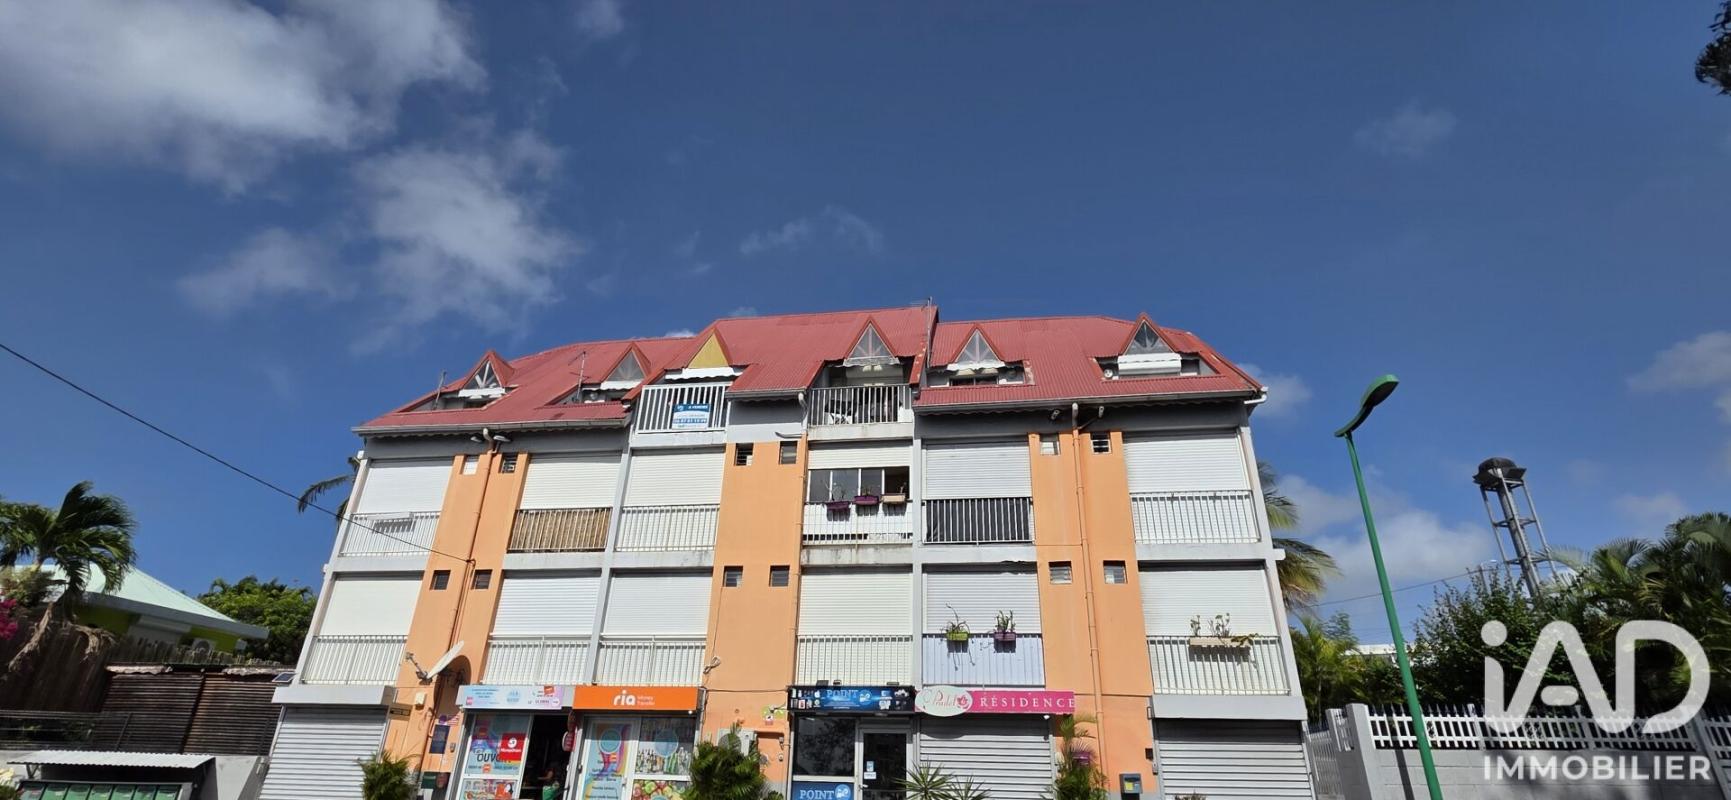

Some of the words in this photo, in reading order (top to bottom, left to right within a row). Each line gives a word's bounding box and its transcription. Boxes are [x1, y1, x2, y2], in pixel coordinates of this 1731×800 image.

[613, 689, 636, 706] ria
[826, 689, 859, 698] POINT
[980, 695, 1075, 708] RÉSIDENCE
[800, 789, 834, 800] POINT
